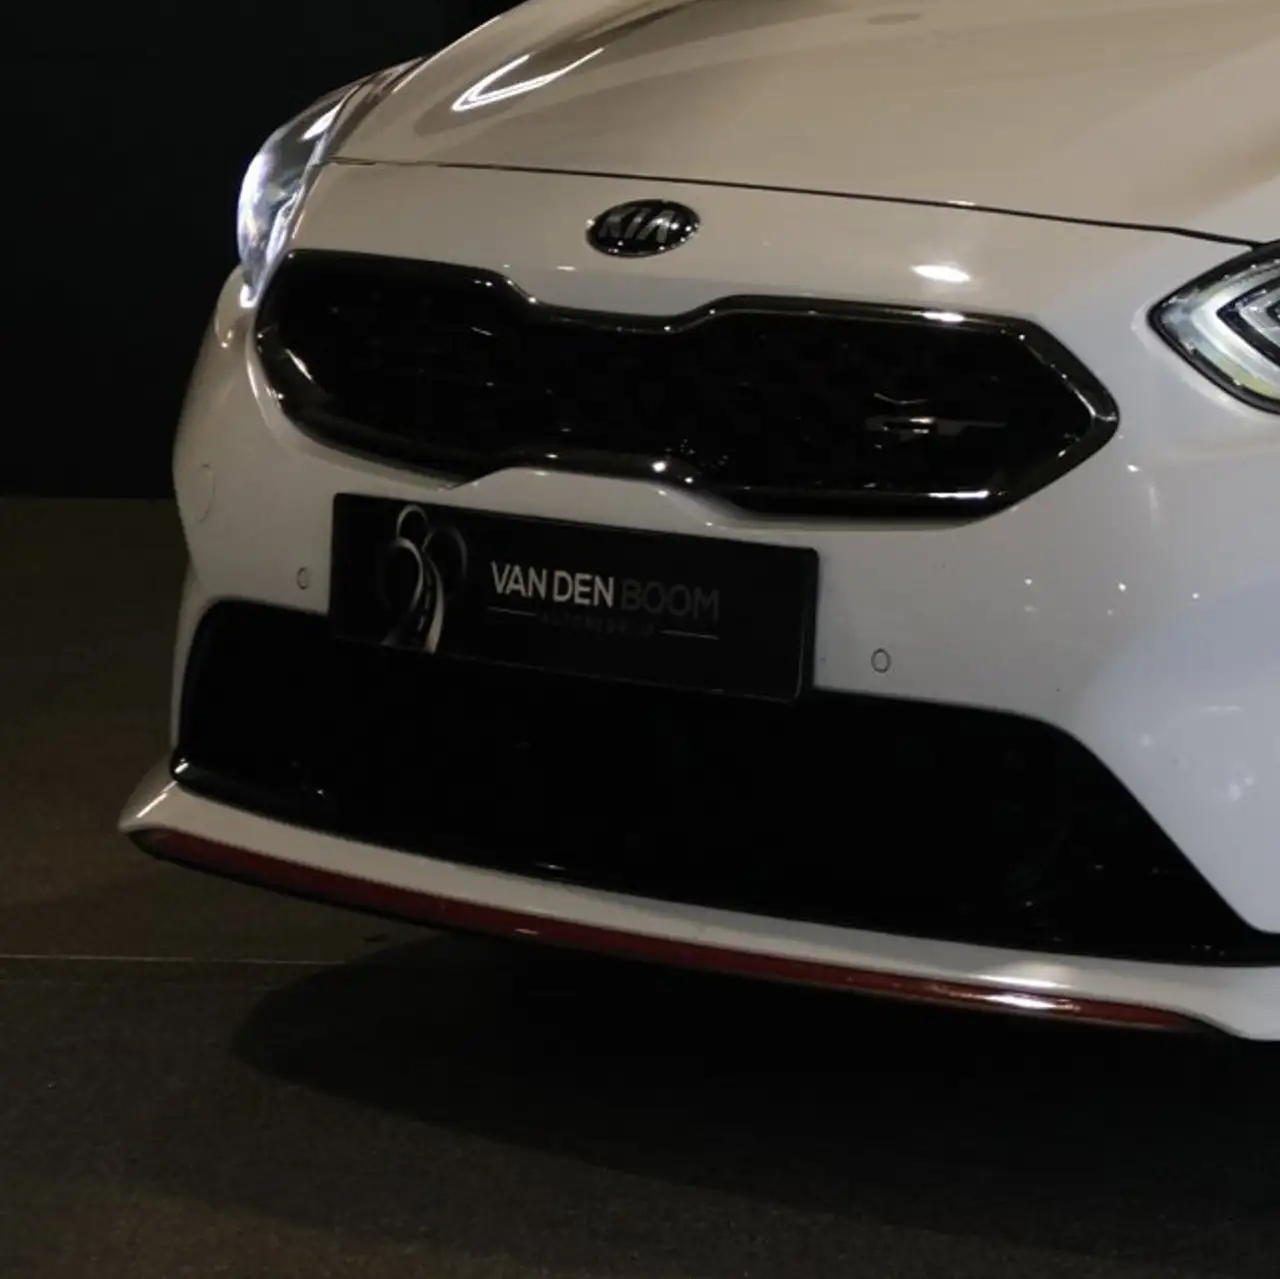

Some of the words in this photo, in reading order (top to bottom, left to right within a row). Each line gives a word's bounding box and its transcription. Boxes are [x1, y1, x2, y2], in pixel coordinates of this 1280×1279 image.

[489, 559, 549, 601] VAN
[552, 569, 615, 609] DEN
[620, 578, 721, 621] BOOM
